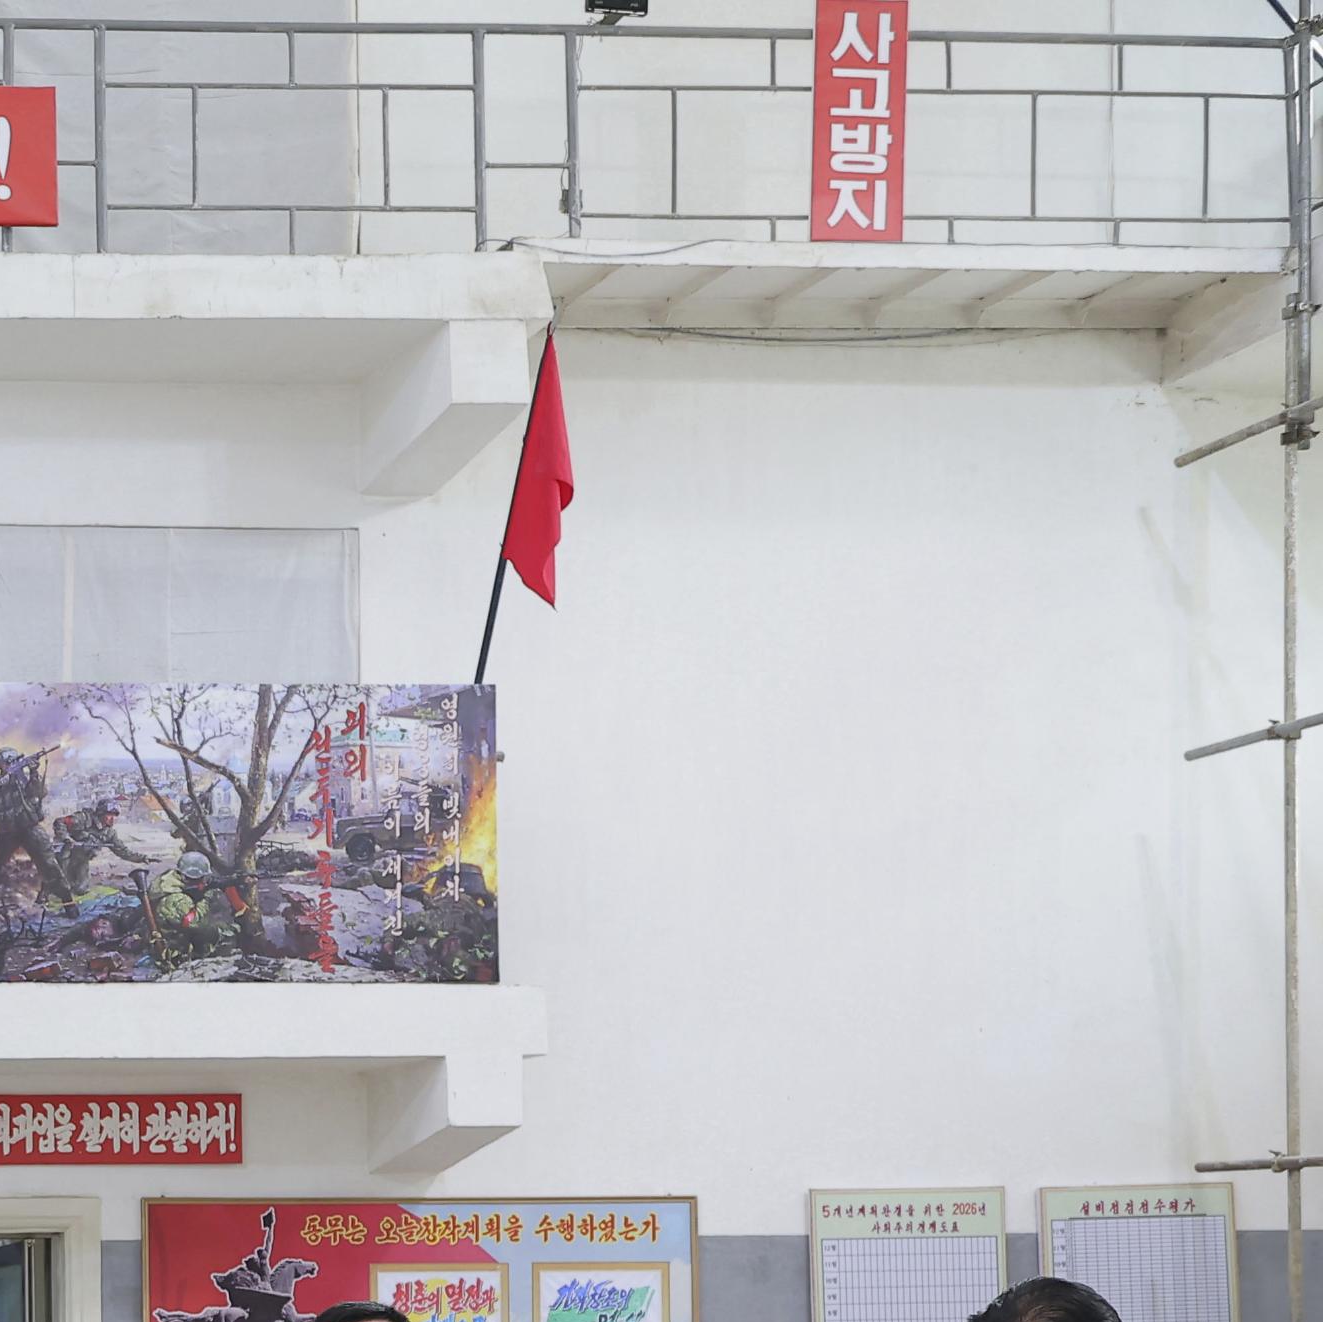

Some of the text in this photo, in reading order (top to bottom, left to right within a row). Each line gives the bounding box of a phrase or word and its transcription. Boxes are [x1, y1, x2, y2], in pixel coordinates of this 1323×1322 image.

[826, 11, 897, 232] 사고방지
[141, 1100, 238, 1156] 관철하자!
[299, 1214, 367, 1245] 동무는
[534, 1212, 661, 1244] 수행하였는가
[952, 1202, 987, 1217] 2026년
